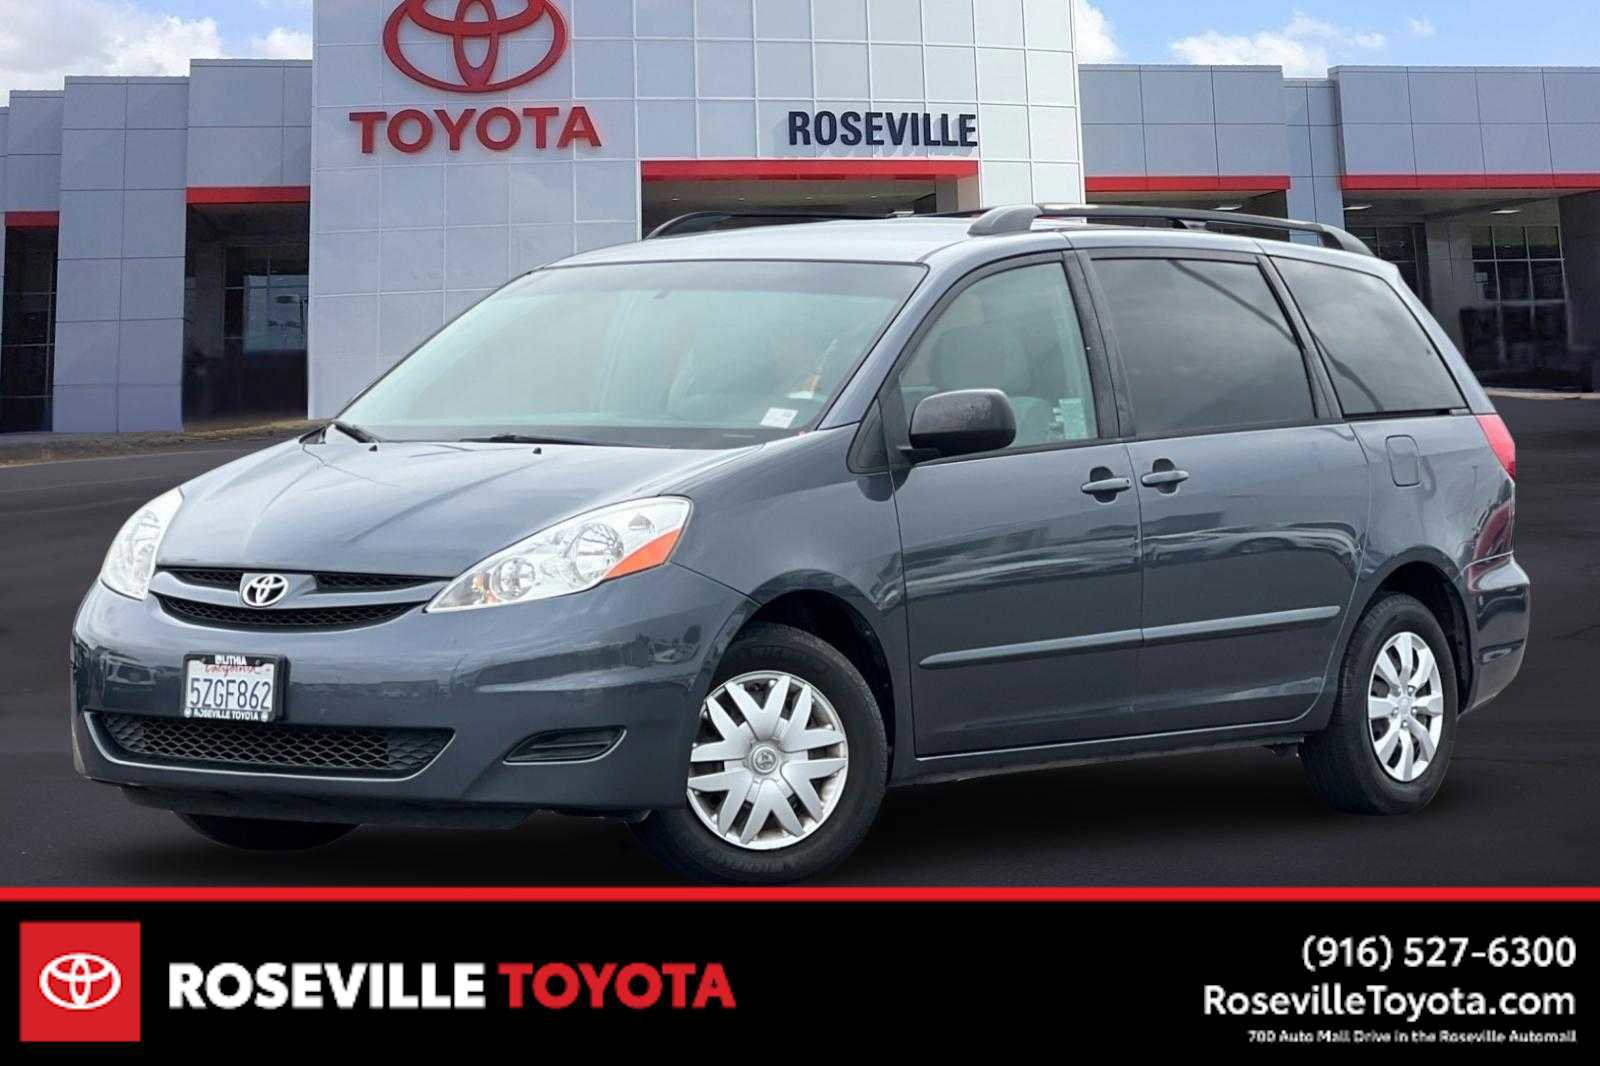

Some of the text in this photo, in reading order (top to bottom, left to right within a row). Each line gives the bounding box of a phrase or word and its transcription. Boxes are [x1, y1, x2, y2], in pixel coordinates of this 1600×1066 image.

[349, 106, 602, 154] TOYOTA
[788, 110, 978, 147] ROSEVILLE
[190, 678, 271, 709] 5ZGF862
[231, 710, 259, 720] TOYOTA
